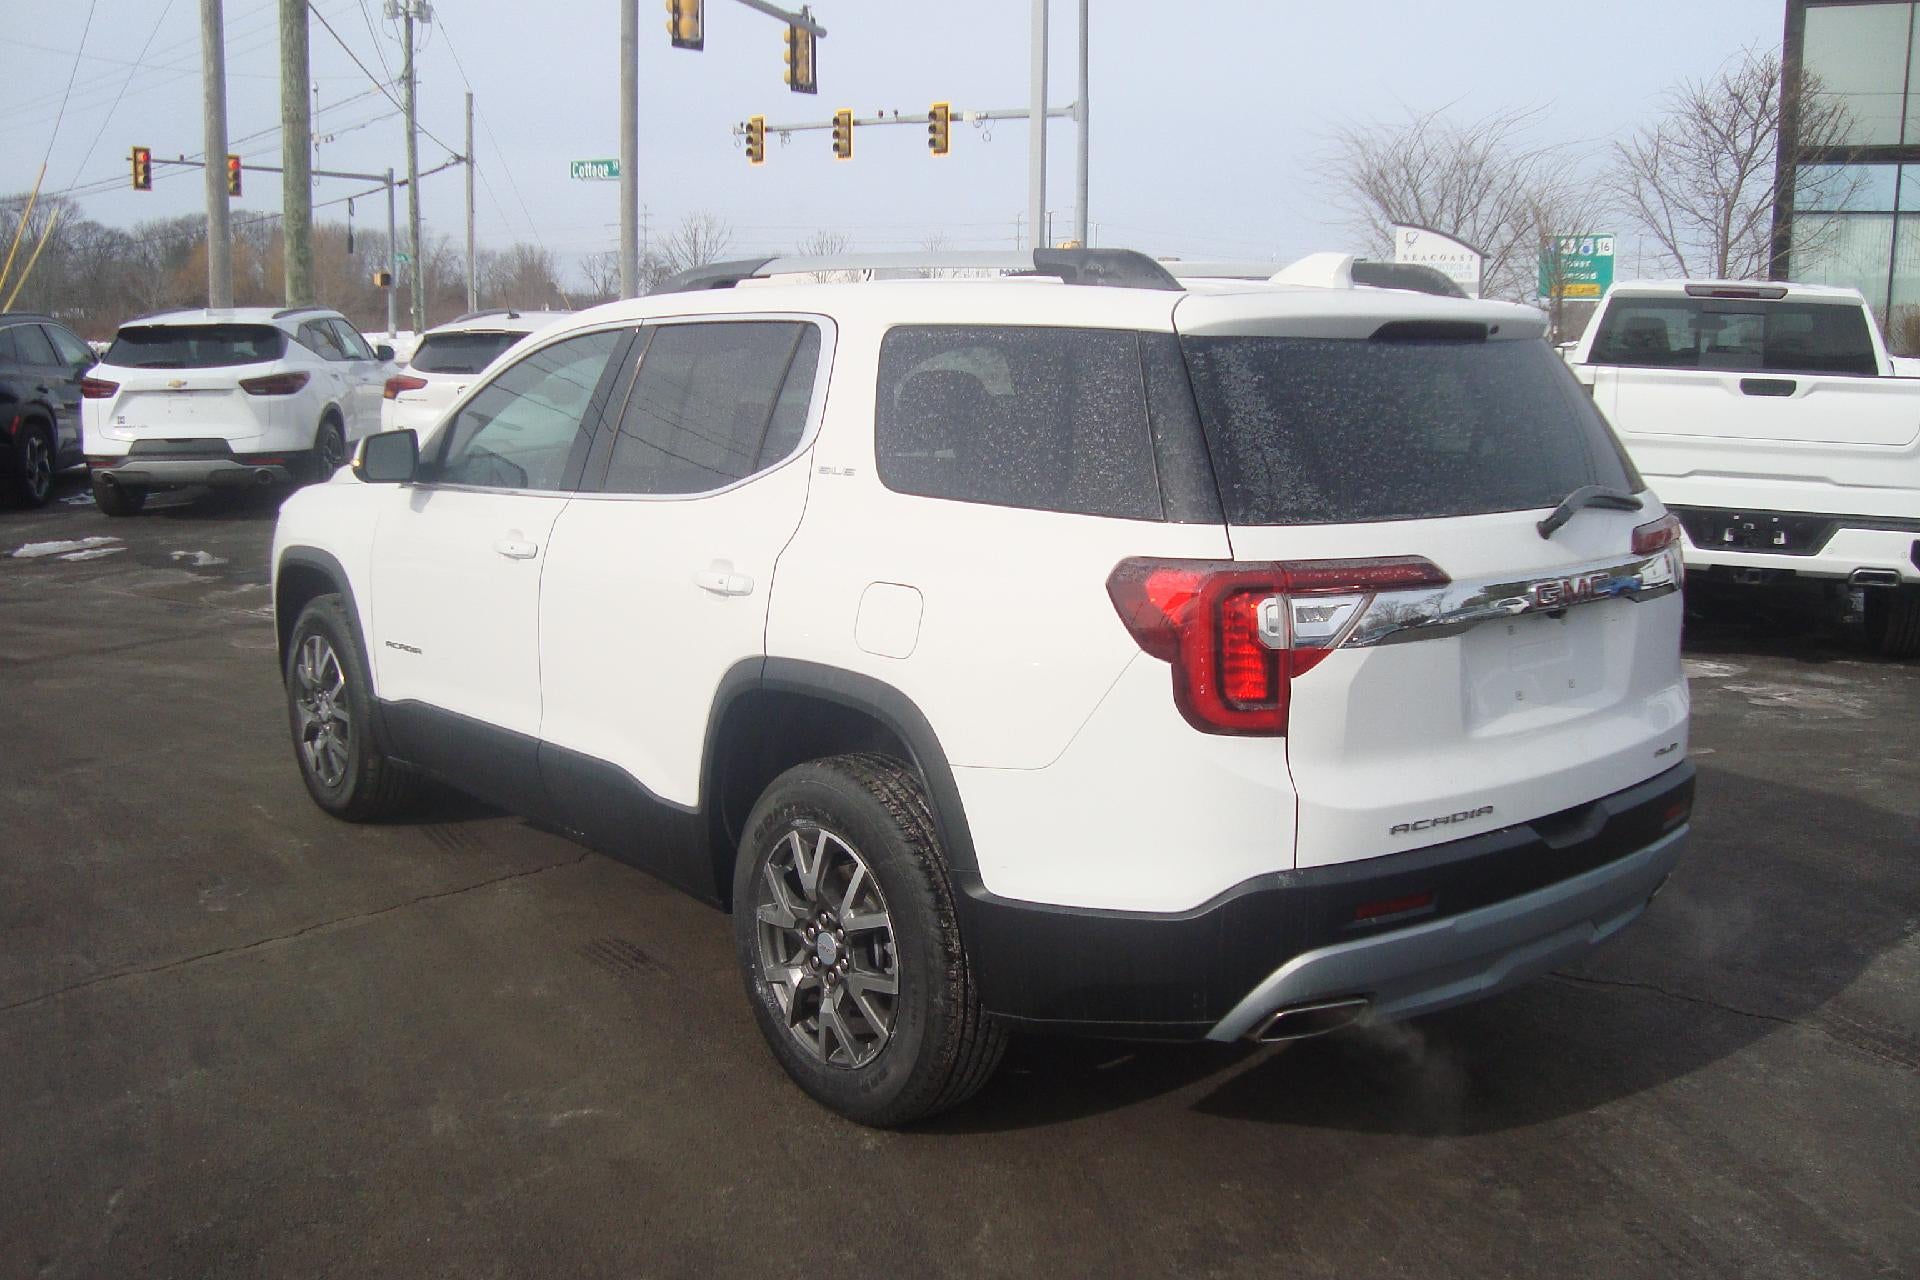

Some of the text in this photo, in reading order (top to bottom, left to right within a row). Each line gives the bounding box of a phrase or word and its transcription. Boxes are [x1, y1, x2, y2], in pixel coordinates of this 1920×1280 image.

[572, 162, 609, 179] Cottage
[1600, 242, 1610, 252] 16
[1402, 254, 1475, 262] SEACOAST
[1535, 572, 1610, 609] GMC
[385, 640, 422, 655] ACADIA
[1389, 805, 1494, 836] ACADIA
